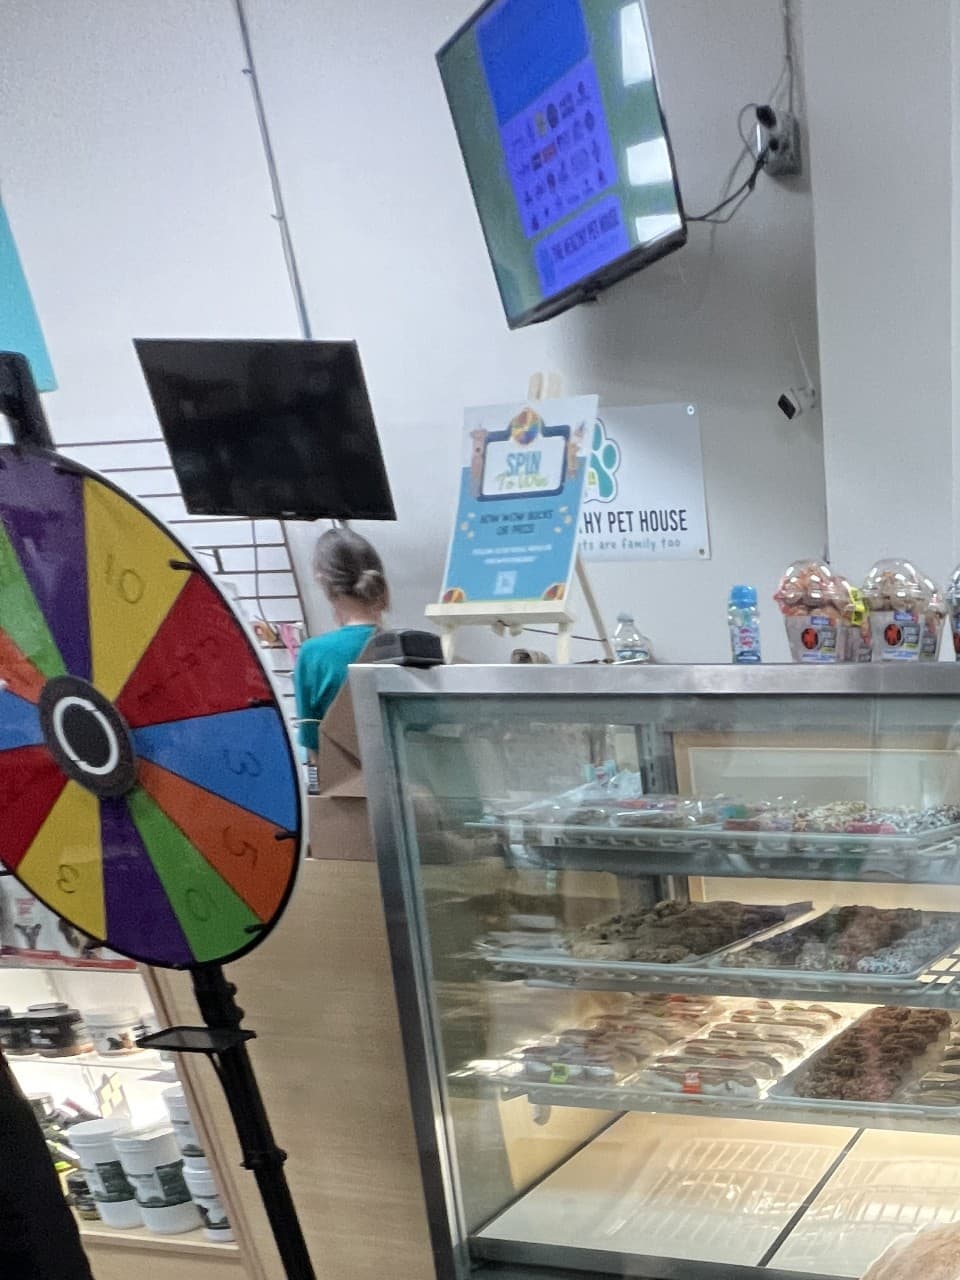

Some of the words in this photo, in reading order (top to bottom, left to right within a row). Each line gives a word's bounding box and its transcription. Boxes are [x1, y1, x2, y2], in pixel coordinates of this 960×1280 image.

[505, 450, 543, 477] SPIN
[579, 511, 602, 534] HY
[608, 511, 634, 534] PET
[639, 509, 689, 533] HOUSE
[600, 540, 617, 550] are
[622, 538, 656, 552] family
[661, 538, 681, 548] too
